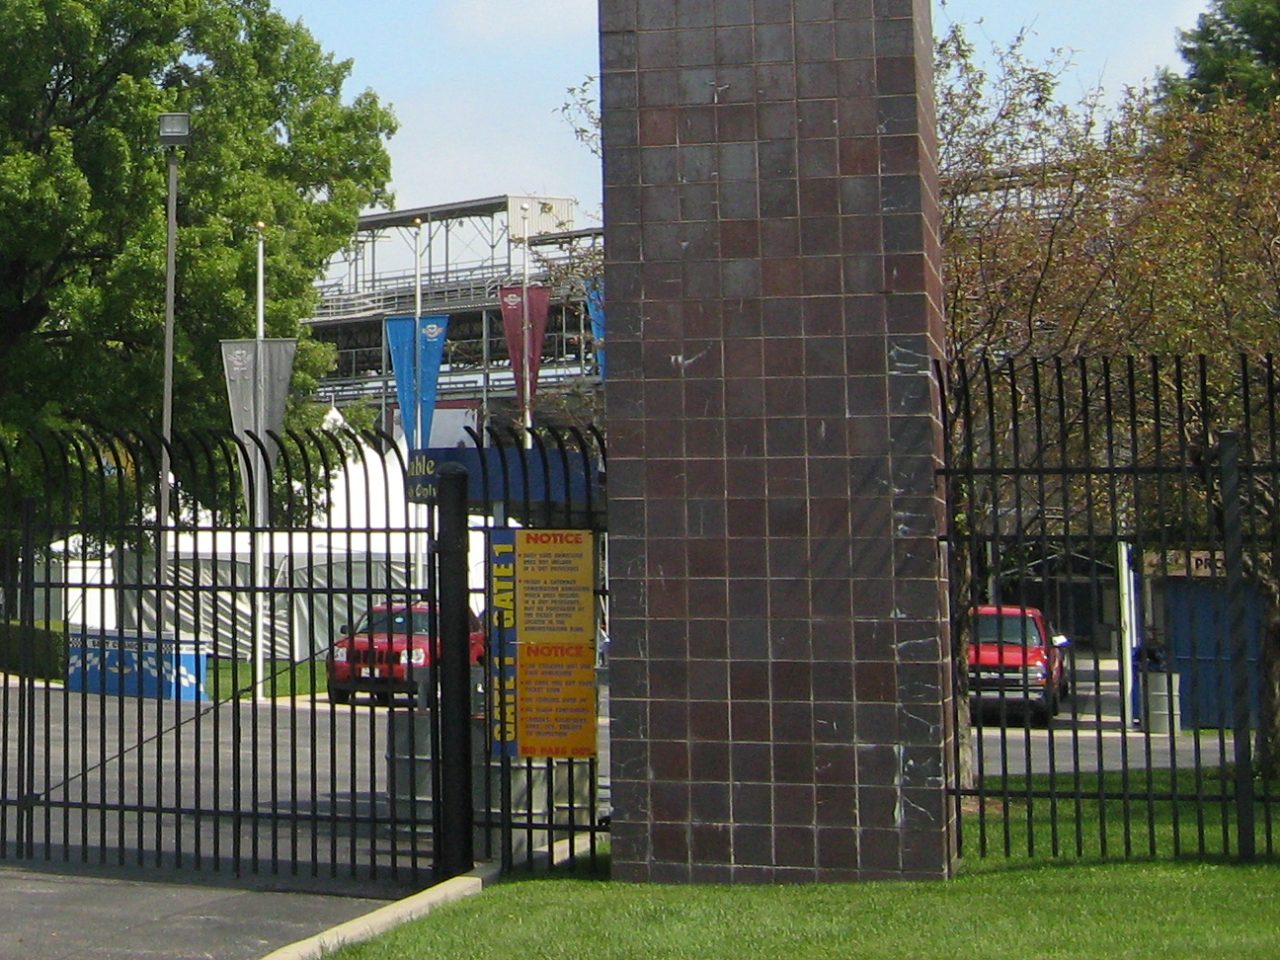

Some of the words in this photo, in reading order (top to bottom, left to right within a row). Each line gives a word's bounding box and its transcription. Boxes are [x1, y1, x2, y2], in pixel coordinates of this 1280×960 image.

[526, 533, 583, 544] NOTICE
[493, 563, 515, 628] GATE
[527, 646, 583, 656] NOTICE
